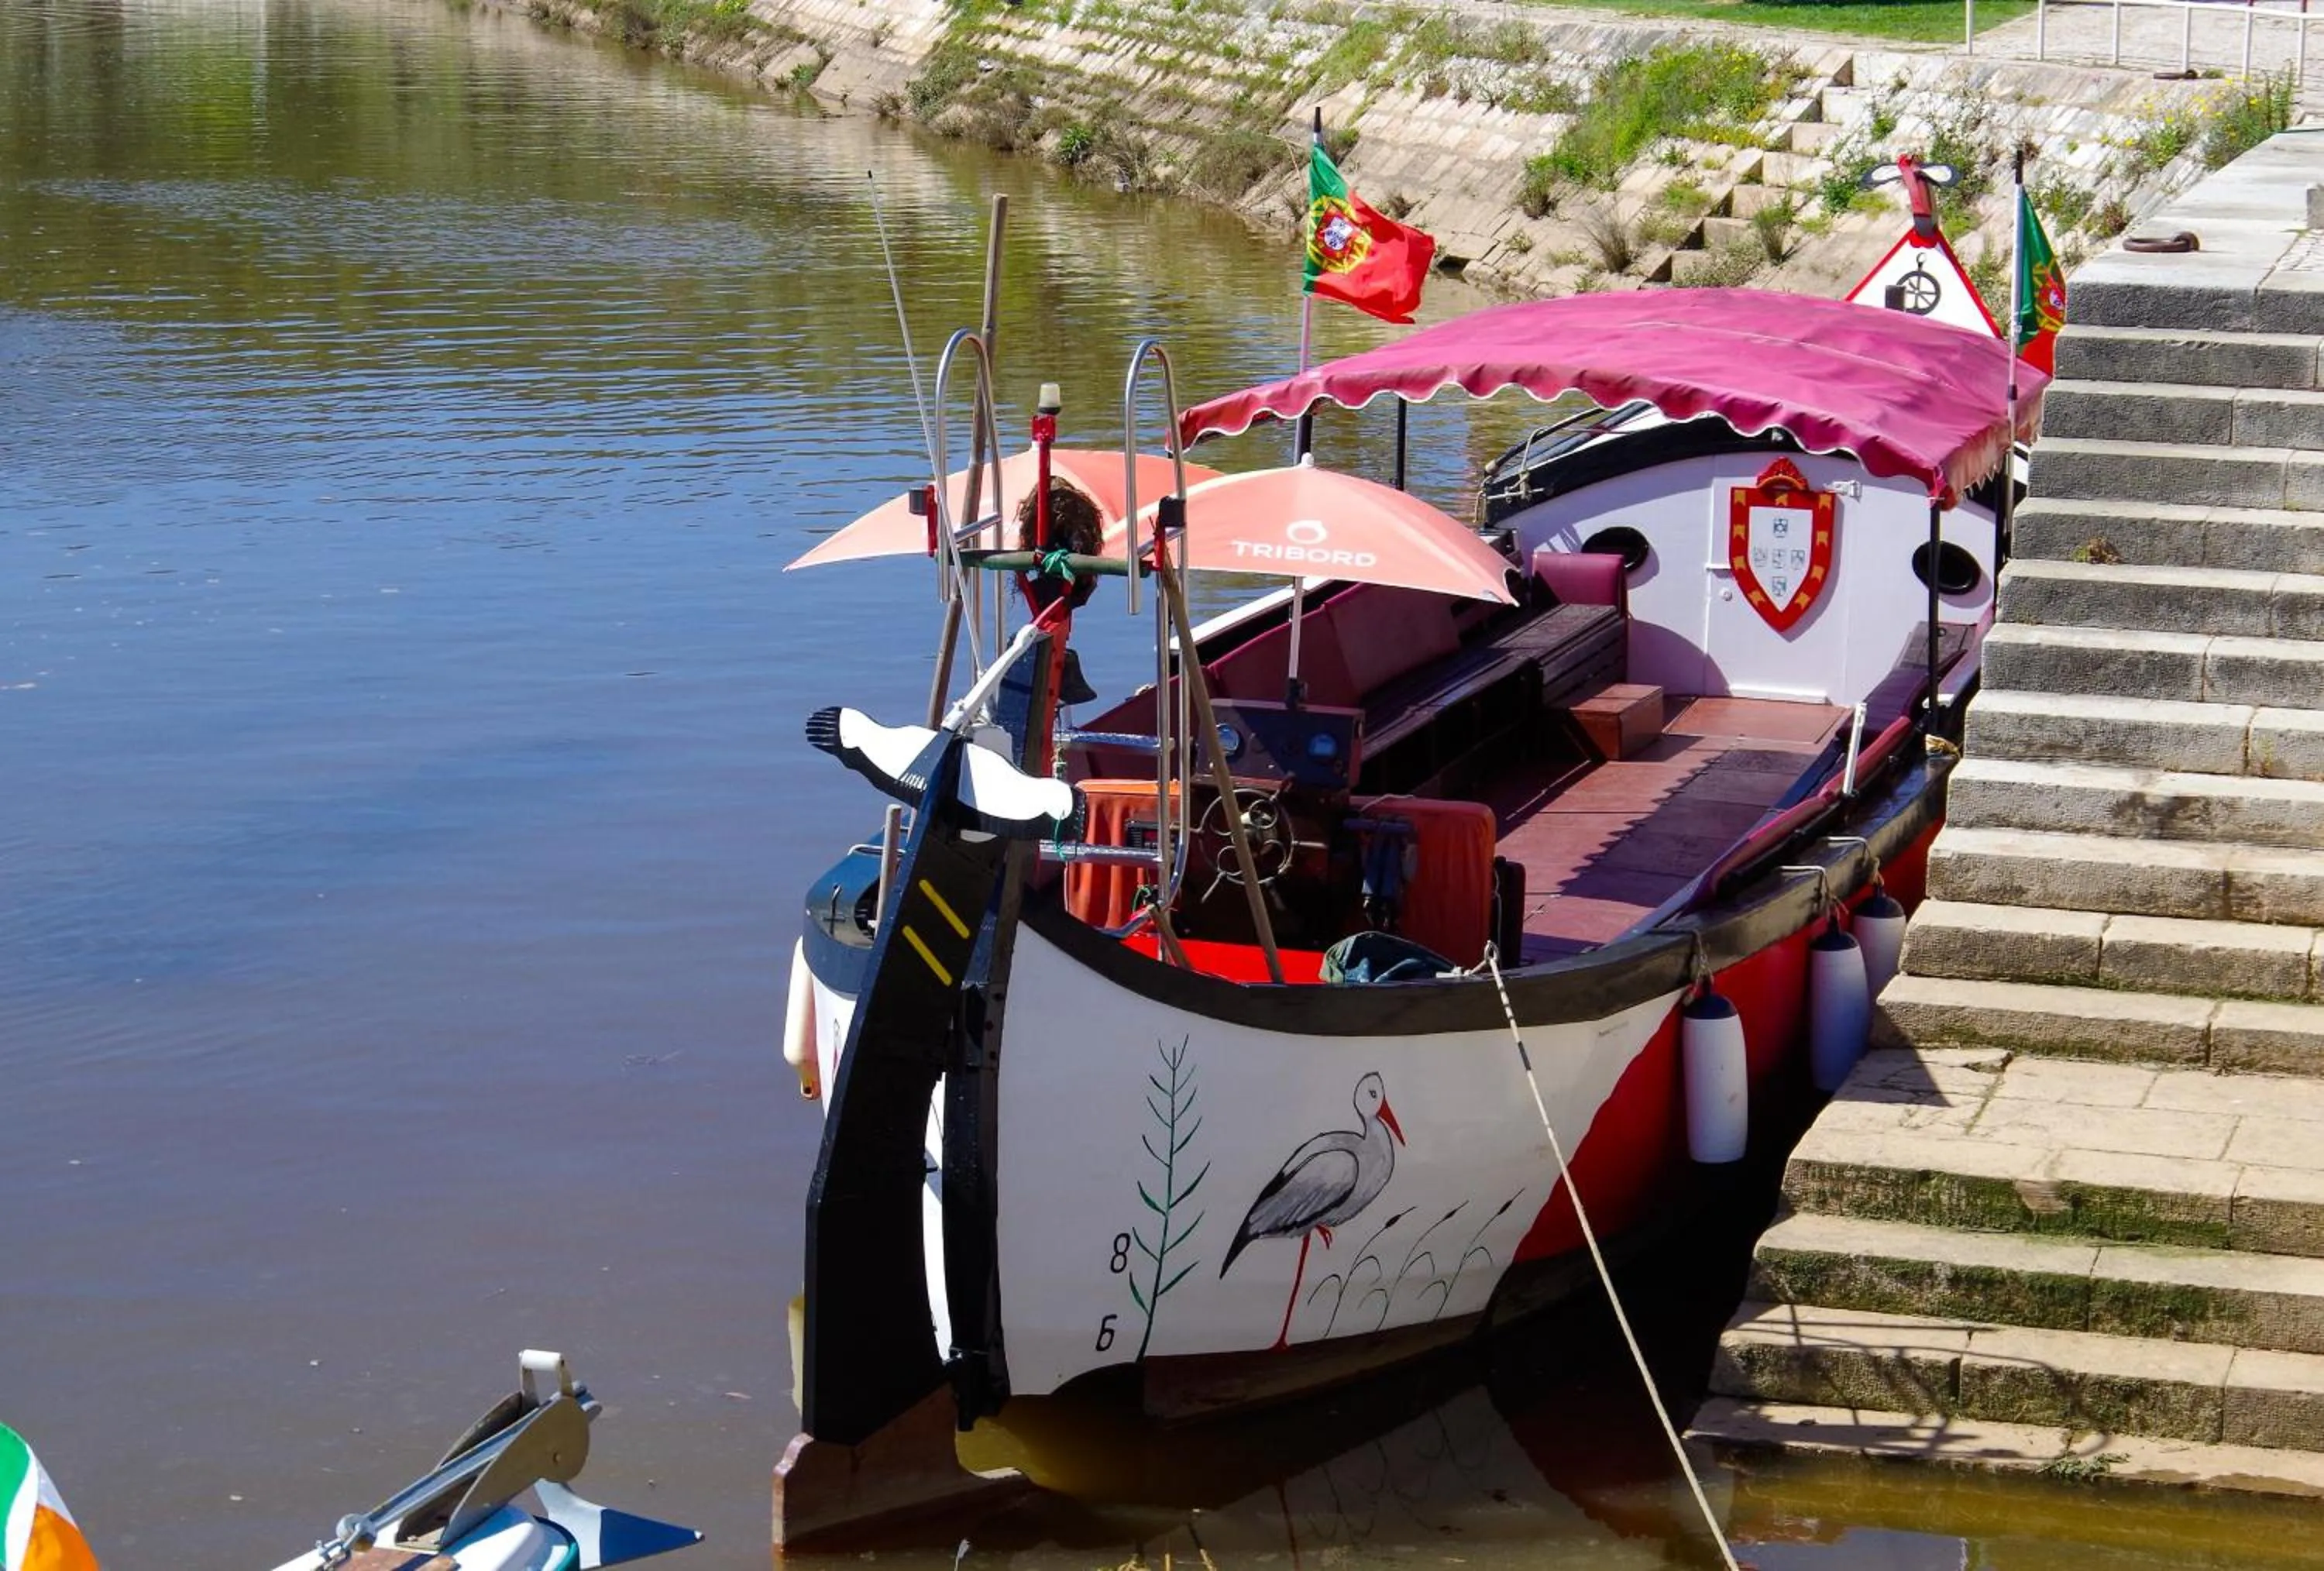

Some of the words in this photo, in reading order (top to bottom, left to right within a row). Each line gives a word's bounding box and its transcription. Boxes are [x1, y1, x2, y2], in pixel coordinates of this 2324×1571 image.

[1231, 539, 1377, 567] TRIBORD
[1110, 1232, 1131, 1274] 8
[1095, 1313, 1118, 1352] 6
